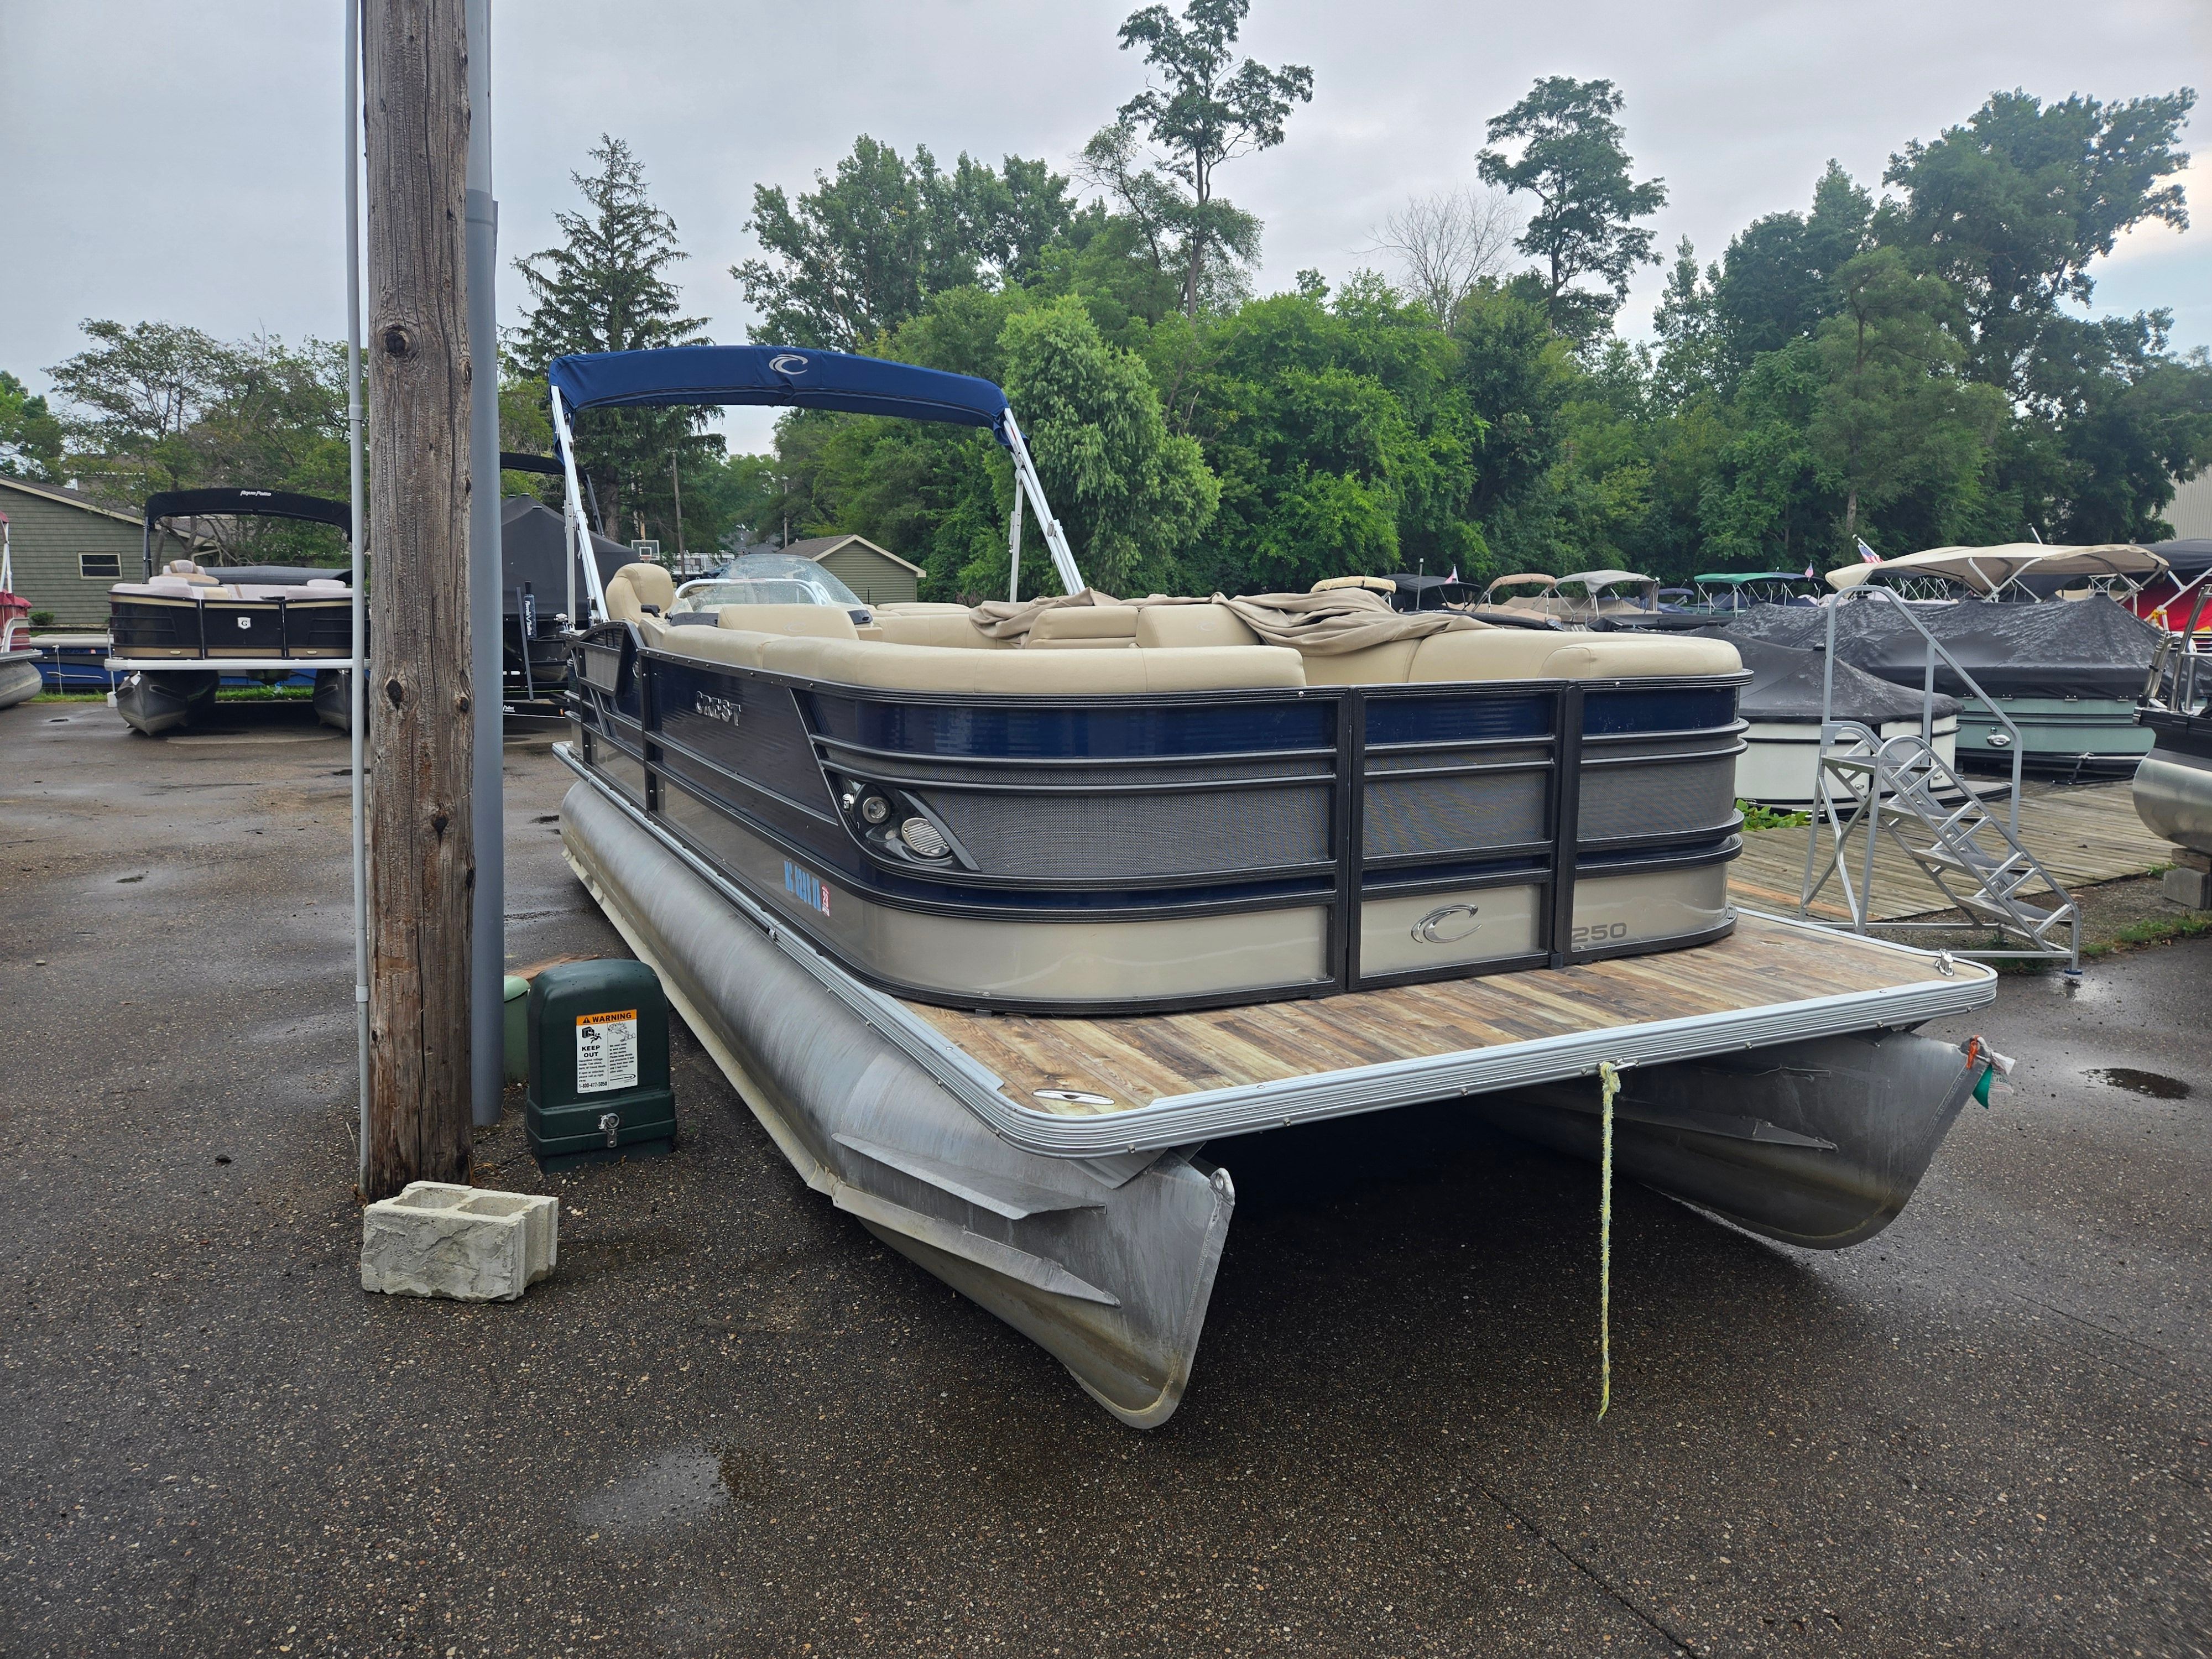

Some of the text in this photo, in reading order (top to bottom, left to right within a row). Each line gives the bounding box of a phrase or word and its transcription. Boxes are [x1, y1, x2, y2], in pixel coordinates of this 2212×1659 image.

[696, 691, 741, 726] CREST
[1572, 922, 1627, 943] 250
[592, 1013, 632, 1023] WARNING
